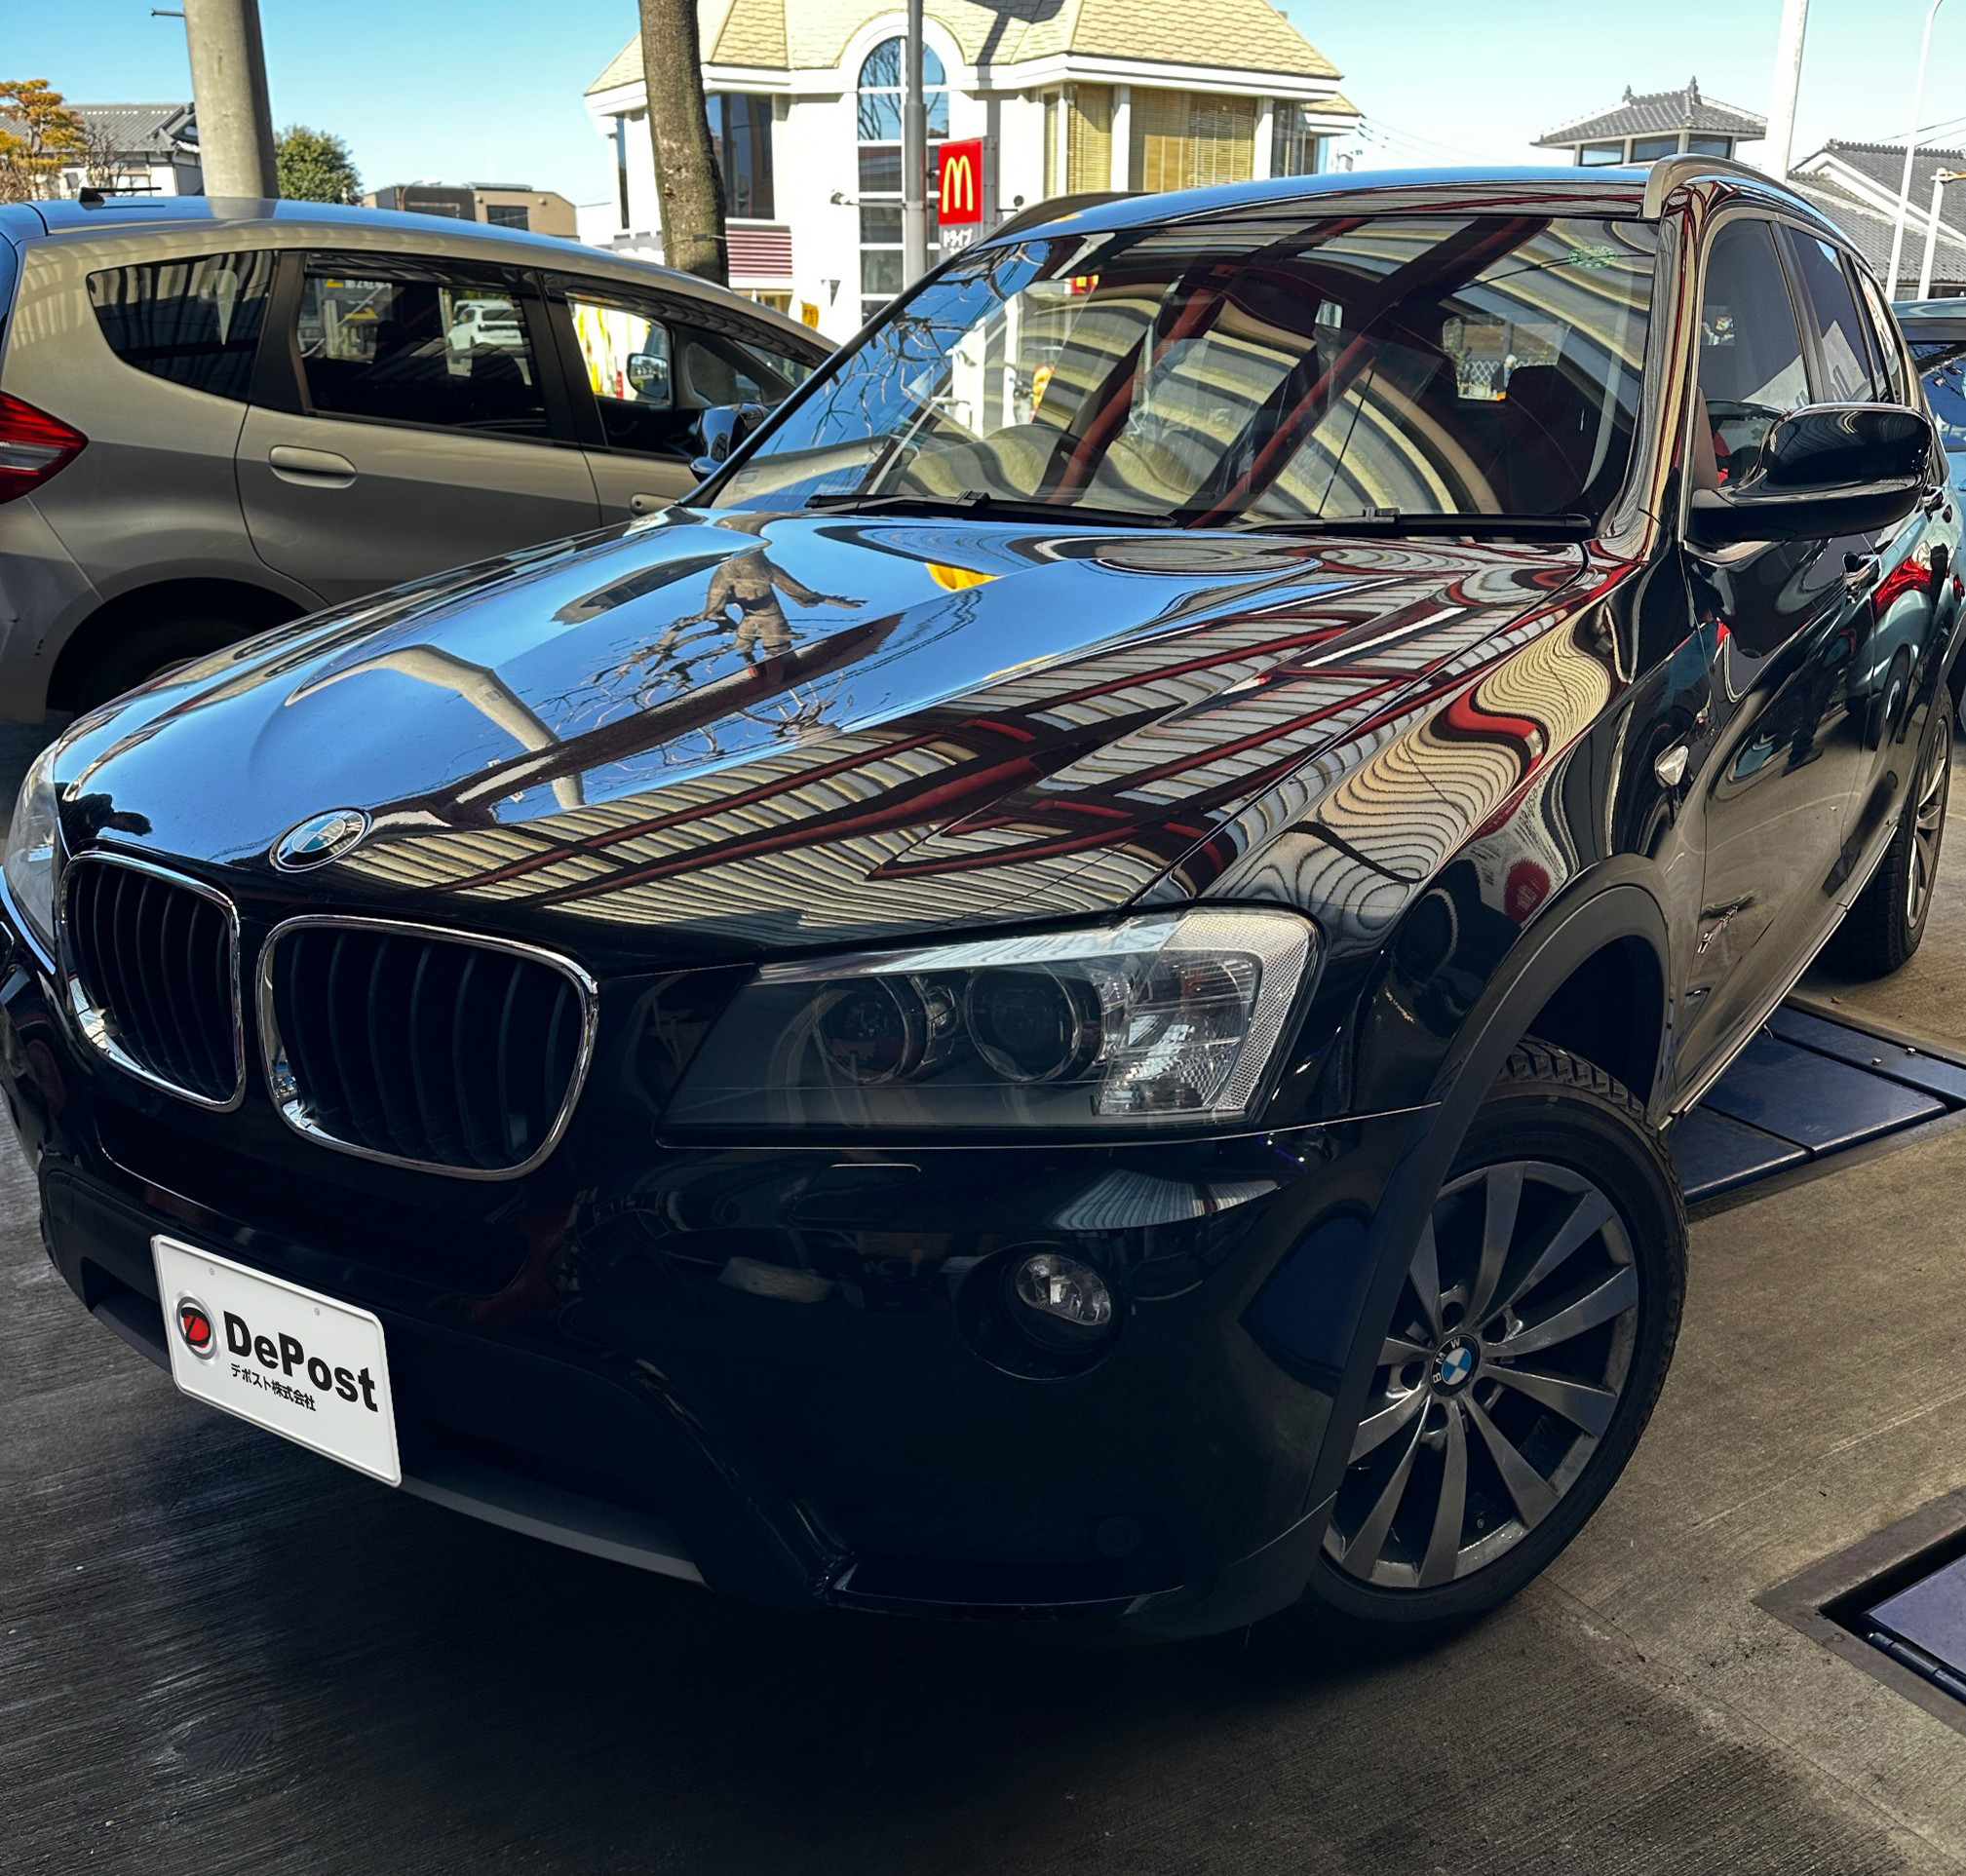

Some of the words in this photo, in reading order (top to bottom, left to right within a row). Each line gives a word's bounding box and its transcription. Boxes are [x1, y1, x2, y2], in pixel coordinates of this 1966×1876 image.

[222, 1310, 379, 1413] DePost
[1432, 1337, 1461, 1384] BMW
[230, 1362, 317, 1412] デポスト株式会社
